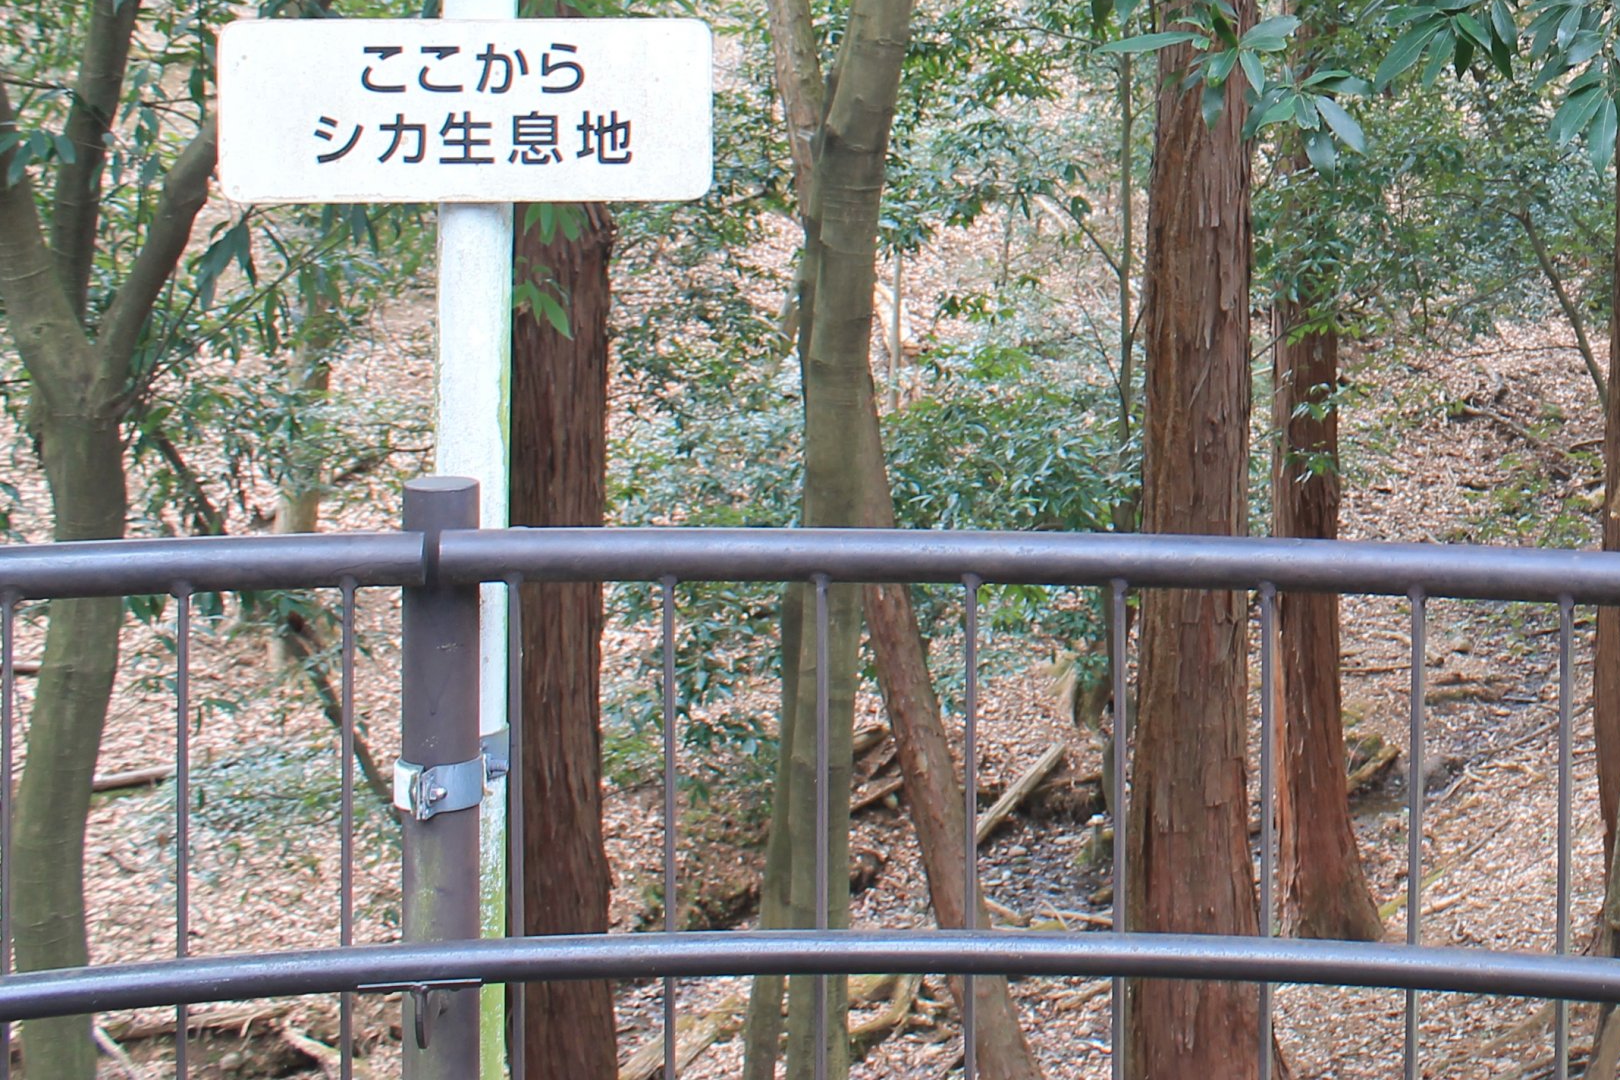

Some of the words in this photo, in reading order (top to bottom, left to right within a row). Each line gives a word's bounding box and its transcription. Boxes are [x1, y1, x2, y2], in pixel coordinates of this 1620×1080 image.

[361, 43, 585, 94] ここから
[313, 111, 633, 165] シカ生息地
